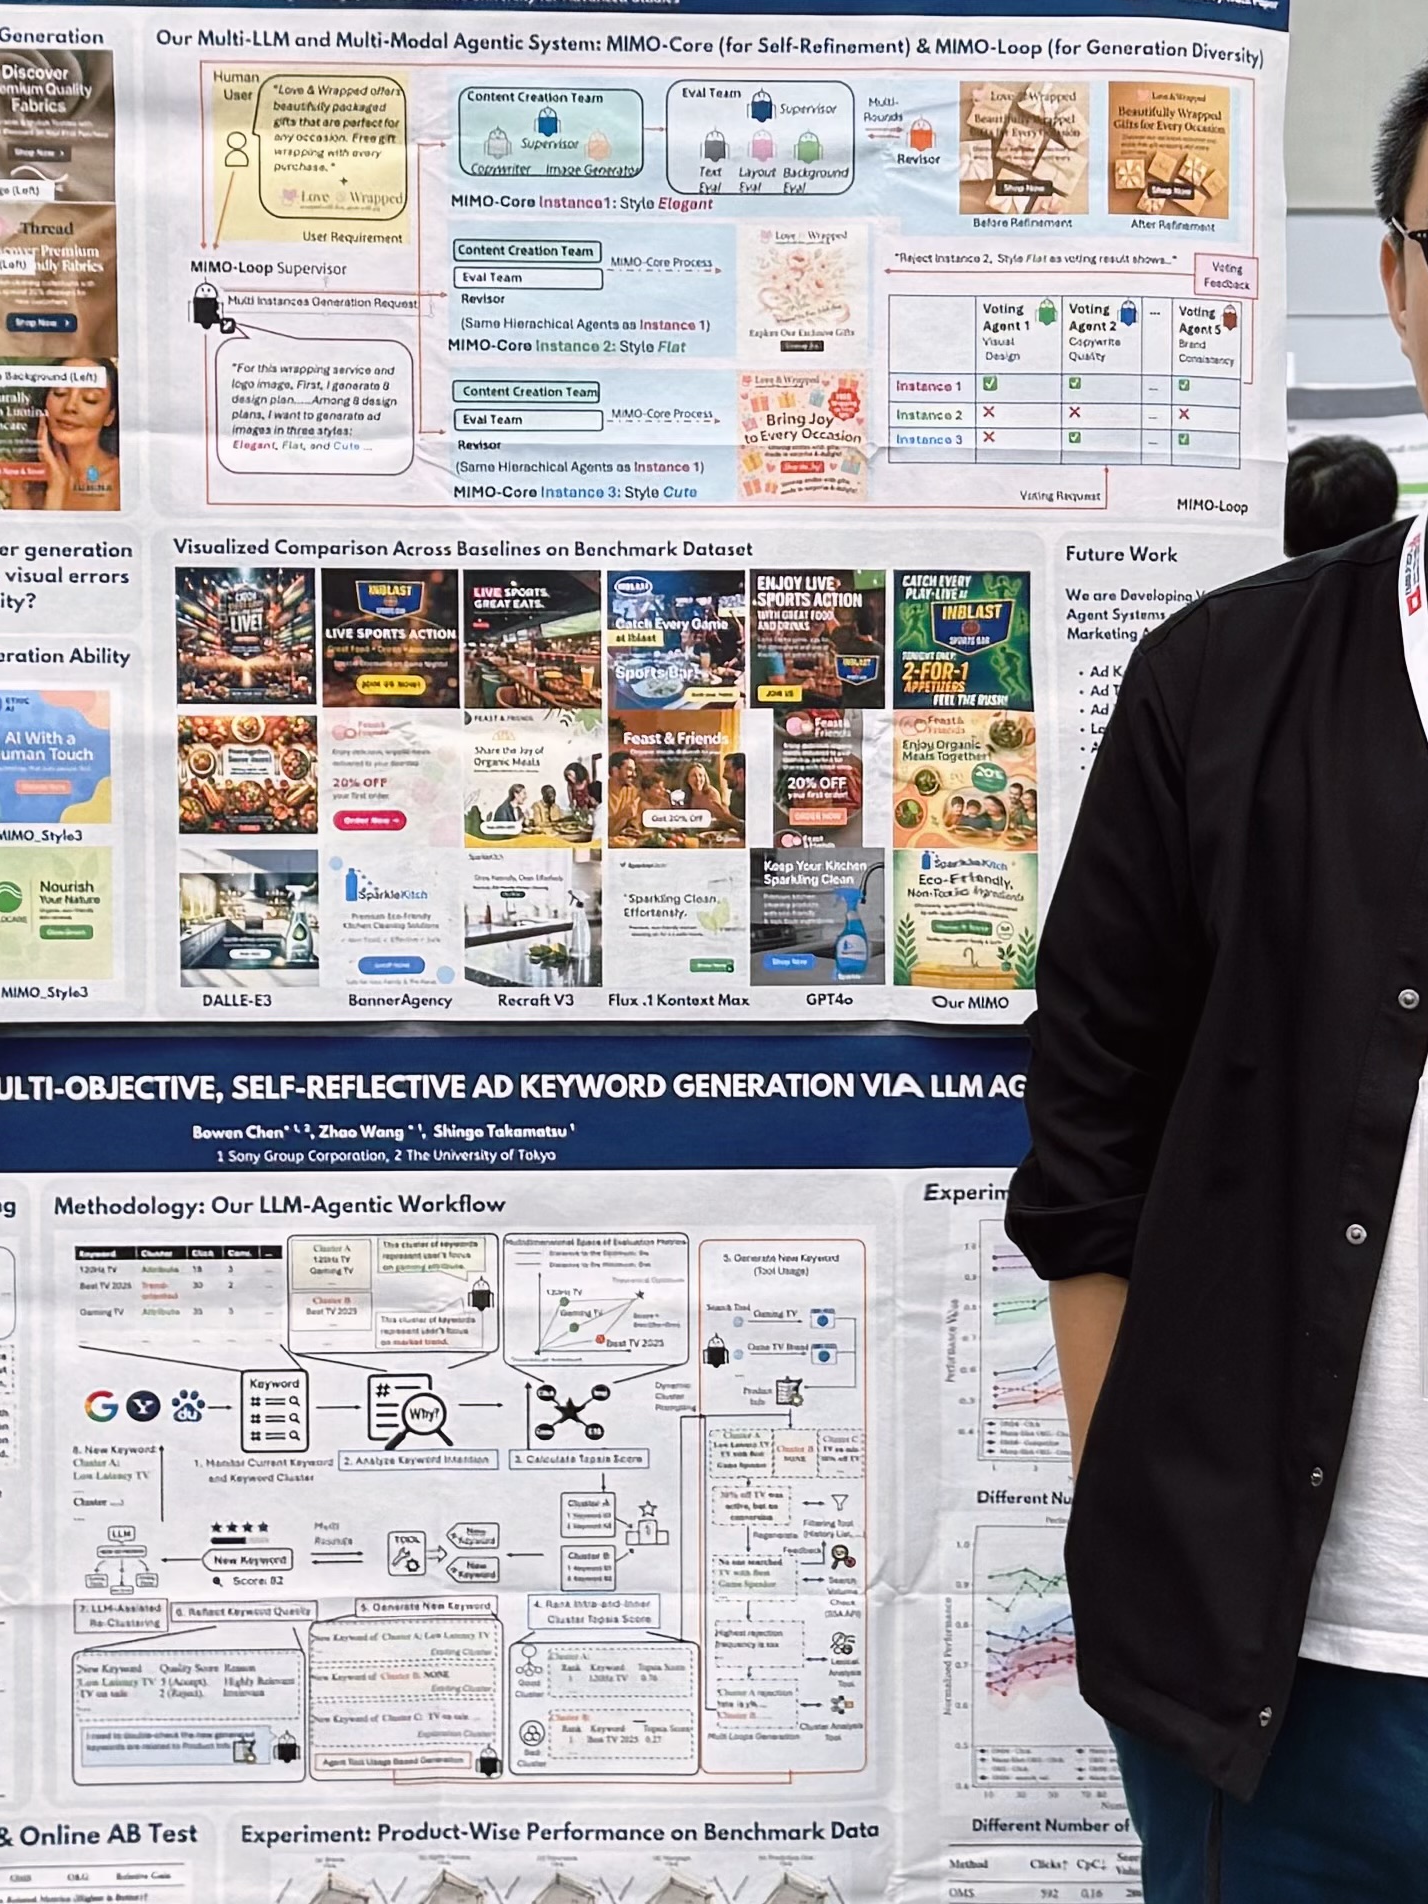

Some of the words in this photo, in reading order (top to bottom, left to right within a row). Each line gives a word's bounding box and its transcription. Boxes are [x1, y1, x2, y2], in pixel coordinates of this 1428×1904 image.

[156, 28, 192, 46] Our
[197, 28, 290, 47] Multi-LLM
[294, 30, 330, 47] and
[335, 30, 448, 49] Multi-Modal
[452, 31, 523, 54] Agentic
[527, 33, 601, 55] System:
[606, 34, 713, 53] MIMO-Core
[718, 35, 753, 58] (for
[757, 35, 910, 58] Self-Refinement)
[915, 37, 931, 54] &
[934, 37, 1042, 59] MIMO-Loop
[1047, 37, 1081, 59] (for
[1086, 38, 1187, 57] Generation
[1192, 41, 1264, 70] Diversity)
[983, 302, 1024, 318] Voting
[983, 319, 1019, 334] Agent
[1024, 320, 1031, 333] 1
[765, 413, 803, 430] Bring
[804, 413, 835, 430] Joy
[1176, 498, 1249, 516] MIMO-Loop
[24, 540, 132, 561] generation
[172, 537, 269, 554] Visualized
[274, 538, 388, 559] Comparison
[392, 539, 452, 556] Across
[456, 539, 540, 556] Baselines
[545, 545, 569, 556] on
[574, 539, 677, 557] Benchmark
[682, 540, 753, 556] Dataset
[1066, 544, 1124, 561] Future
[1128, 545, 1178, 562] Work
[757, 575, 801, 592] ENJOY
[804, 575, 836, 592] LIVE
[757, 592, 811, 608] SPORTS
[813, 592, 863, 609] ACTION
[942, 603, 1003, 620] INBLAST
[68, 646, 130, 668] Ability
[902, 661, 970, 682] 2-FOR-1
[786, 776, 818, 790] 20%
[819, 776, 848, 790] OFF
[0, 985, 88, 1001] MIMO_Style3
[202, 993, 272, 1007] DALLE-E3
[348, 992, 452, 1009] BannerAgency
[497, 992, 551, 1006] Recraft
[553, 992, 574, 1006] V3
[805, 992, 853, 1006] GPT4o
[931, 994, 964, 1009] Our
[967, 995, 1009, 1009] MIMO
[230, 1073, 466, 1100] SELF-REFLECTIVE
[471, 1073, 514, 1098] AD
[520, 1073, 666, 1098] KEYWORD
[672, 1072, 854, 1098] GENERATION
[859, 1072, 925, 1098] VIA
[930, 1073, 984, 1098] LLM
[53, 1195, 204, 1219] Methodology:
[210, 1195, 254, 1214] Our
[259, 1194, 393, 1219] LLM-Agentic
[397, 1193, 506, 1212] Workflow
[18, 1823, 100, 1846] Online
[106, 1822, 141, 1844] AB
[147, 1821, 197, 1843] Test
[240, 1823, 370, 1848] Experiment:
[377, 1820, 520, 1842] Product-Wise
[526, 1820, 665, 1841] Performance
[670, 1828, 697, 1841] on
[704, 1820, 825, 1841] Benchmark
[830, 1820, 879, 1839] Data
